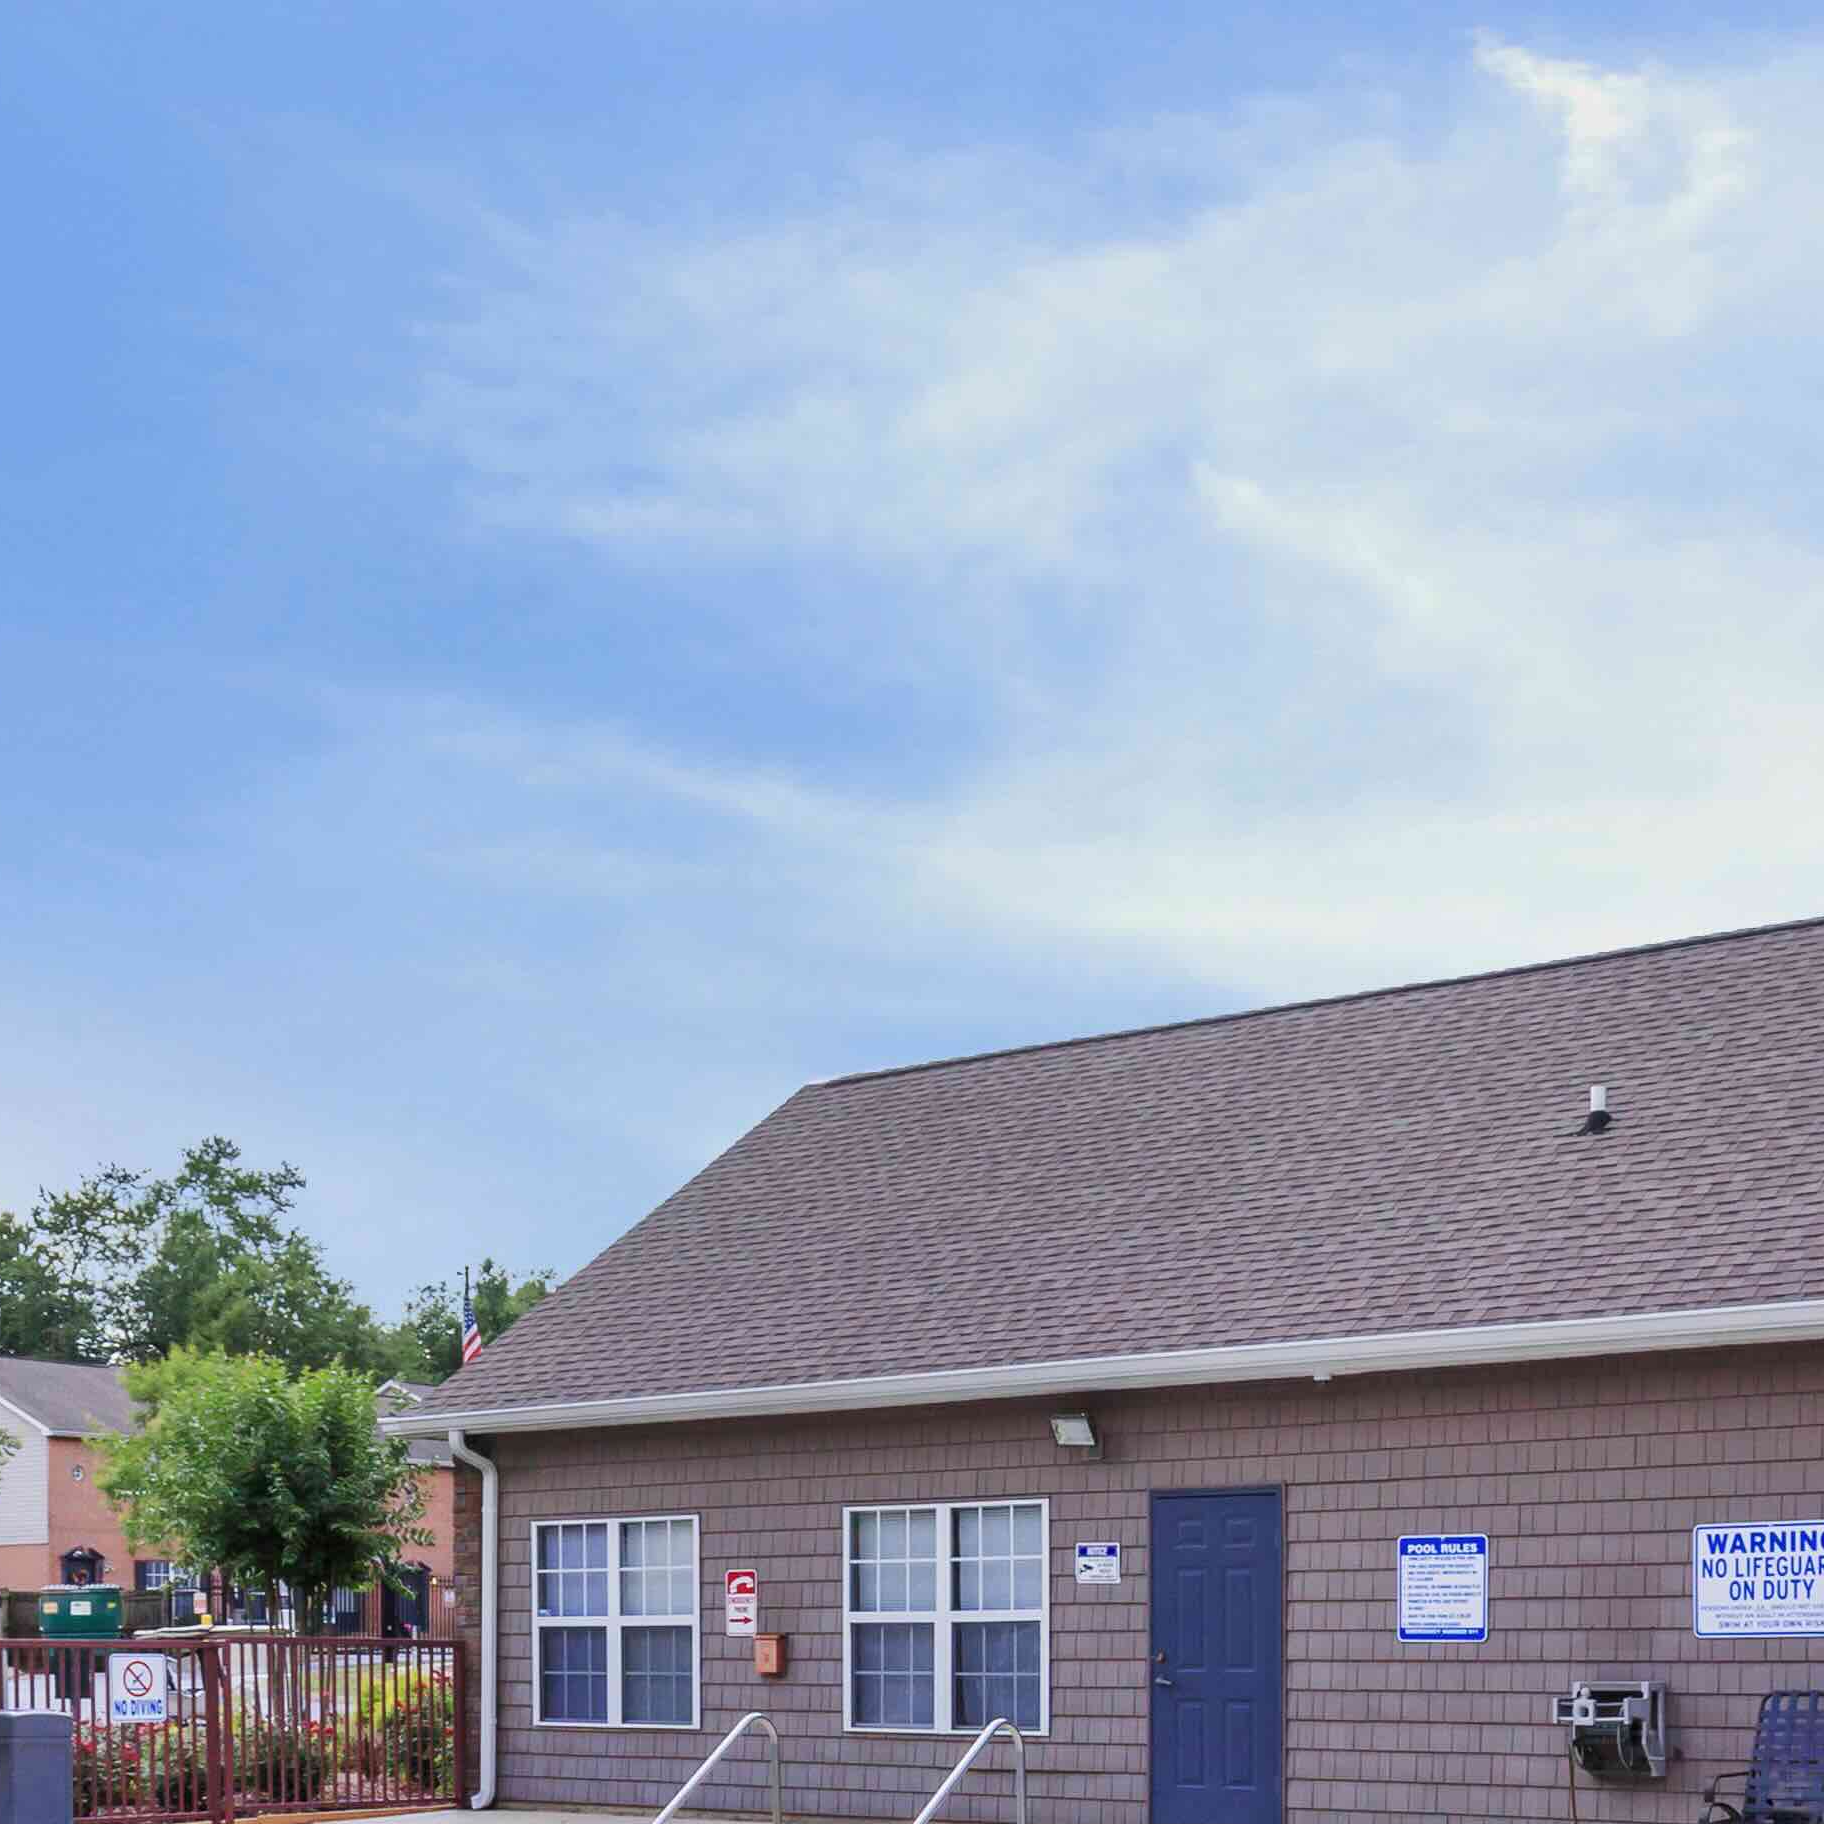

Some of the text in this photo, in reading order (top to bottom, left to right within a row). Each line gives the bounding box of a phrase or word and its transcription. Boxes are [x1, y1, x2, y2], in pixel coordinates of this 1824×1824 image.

[1407, 1543, 1478, 1554] POOL RULES
[1702, 1558, 1728, 1578] NO
[1729, 1578, 1815, 1601] ON DUTY
[114, 1699, 163, 1716] NO DIVING
